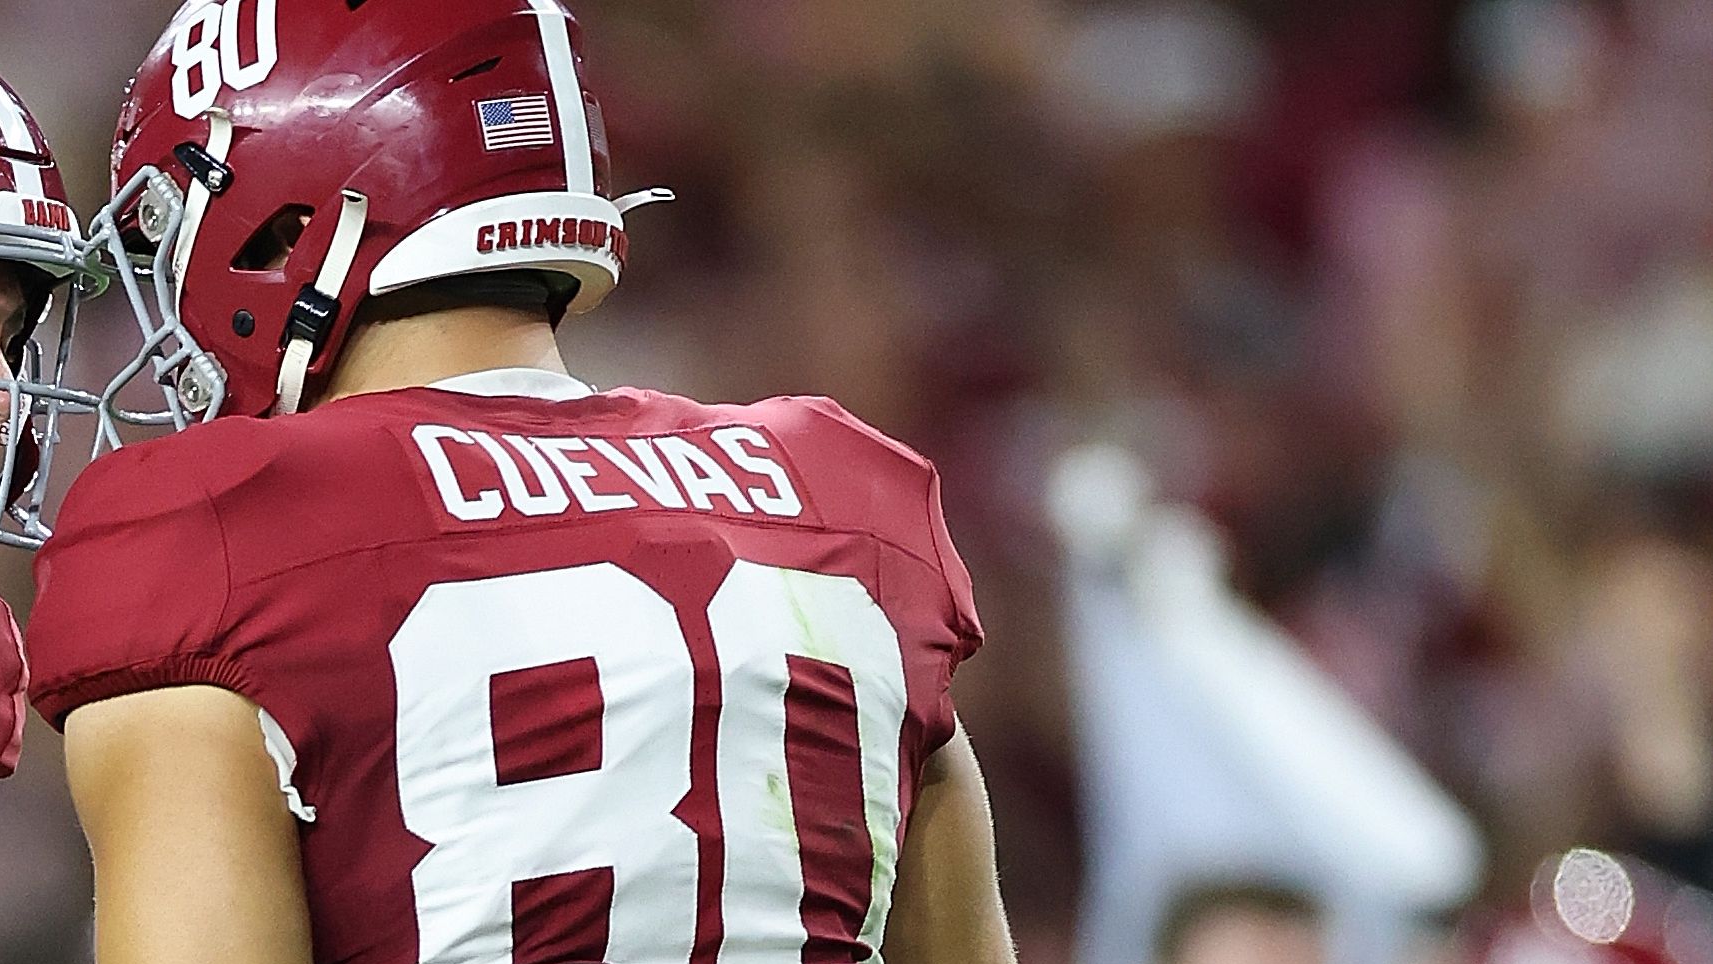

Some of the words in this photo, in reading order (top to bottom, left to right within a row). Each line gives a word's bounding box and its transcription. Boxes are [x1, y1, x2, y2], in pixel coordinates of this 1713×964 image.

[171, 0, 278, 119] 80
[476, 217, 607, 254] CRIMSON
[411, 423, 802, 522] CUEVAS
